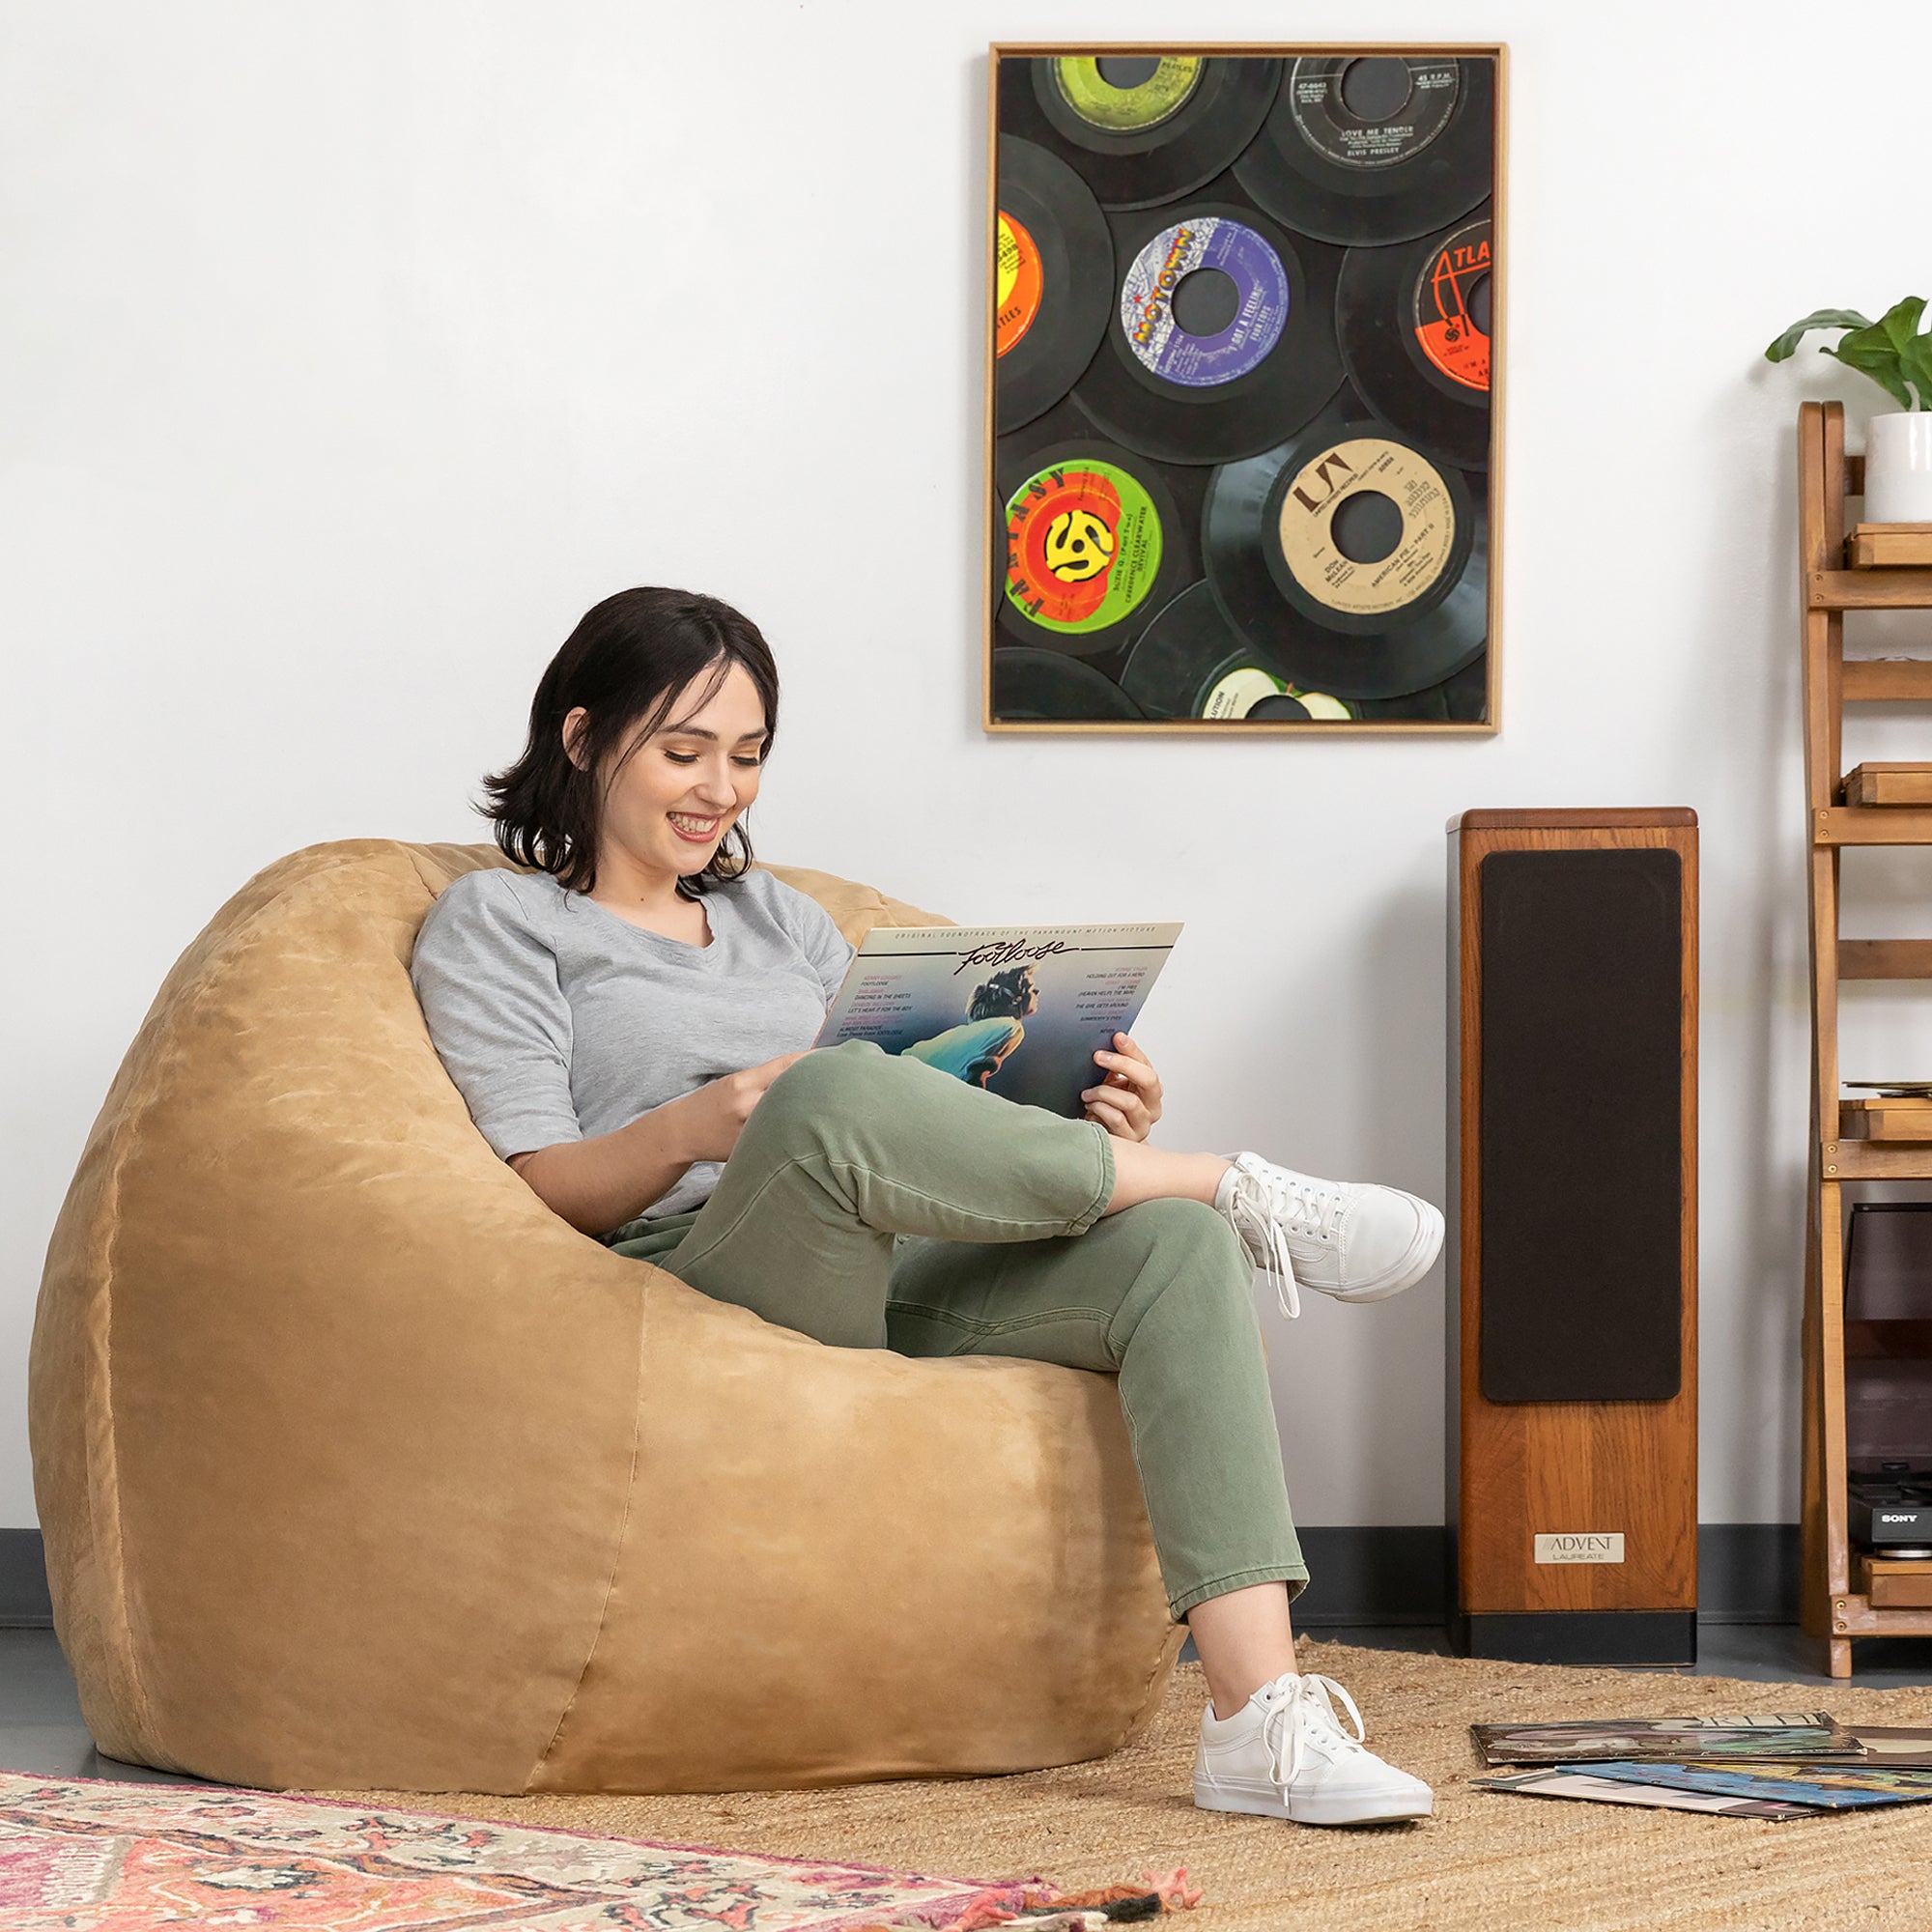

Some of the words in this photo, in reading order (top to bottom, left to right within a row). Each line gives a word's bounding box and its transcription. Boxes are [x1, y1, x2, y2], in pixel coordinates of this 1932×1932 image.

[1133, 228, 1196, 349] MOTOWN
[1231, 327, 1245, 345] GOT
[1324, 559, 1339, 573] DON
[1371, 557, 1401, 587] AMERICAN
[953, 938, 1080, 976] Footloose
[1548, 1537, 1612, 1550] ADVENT
